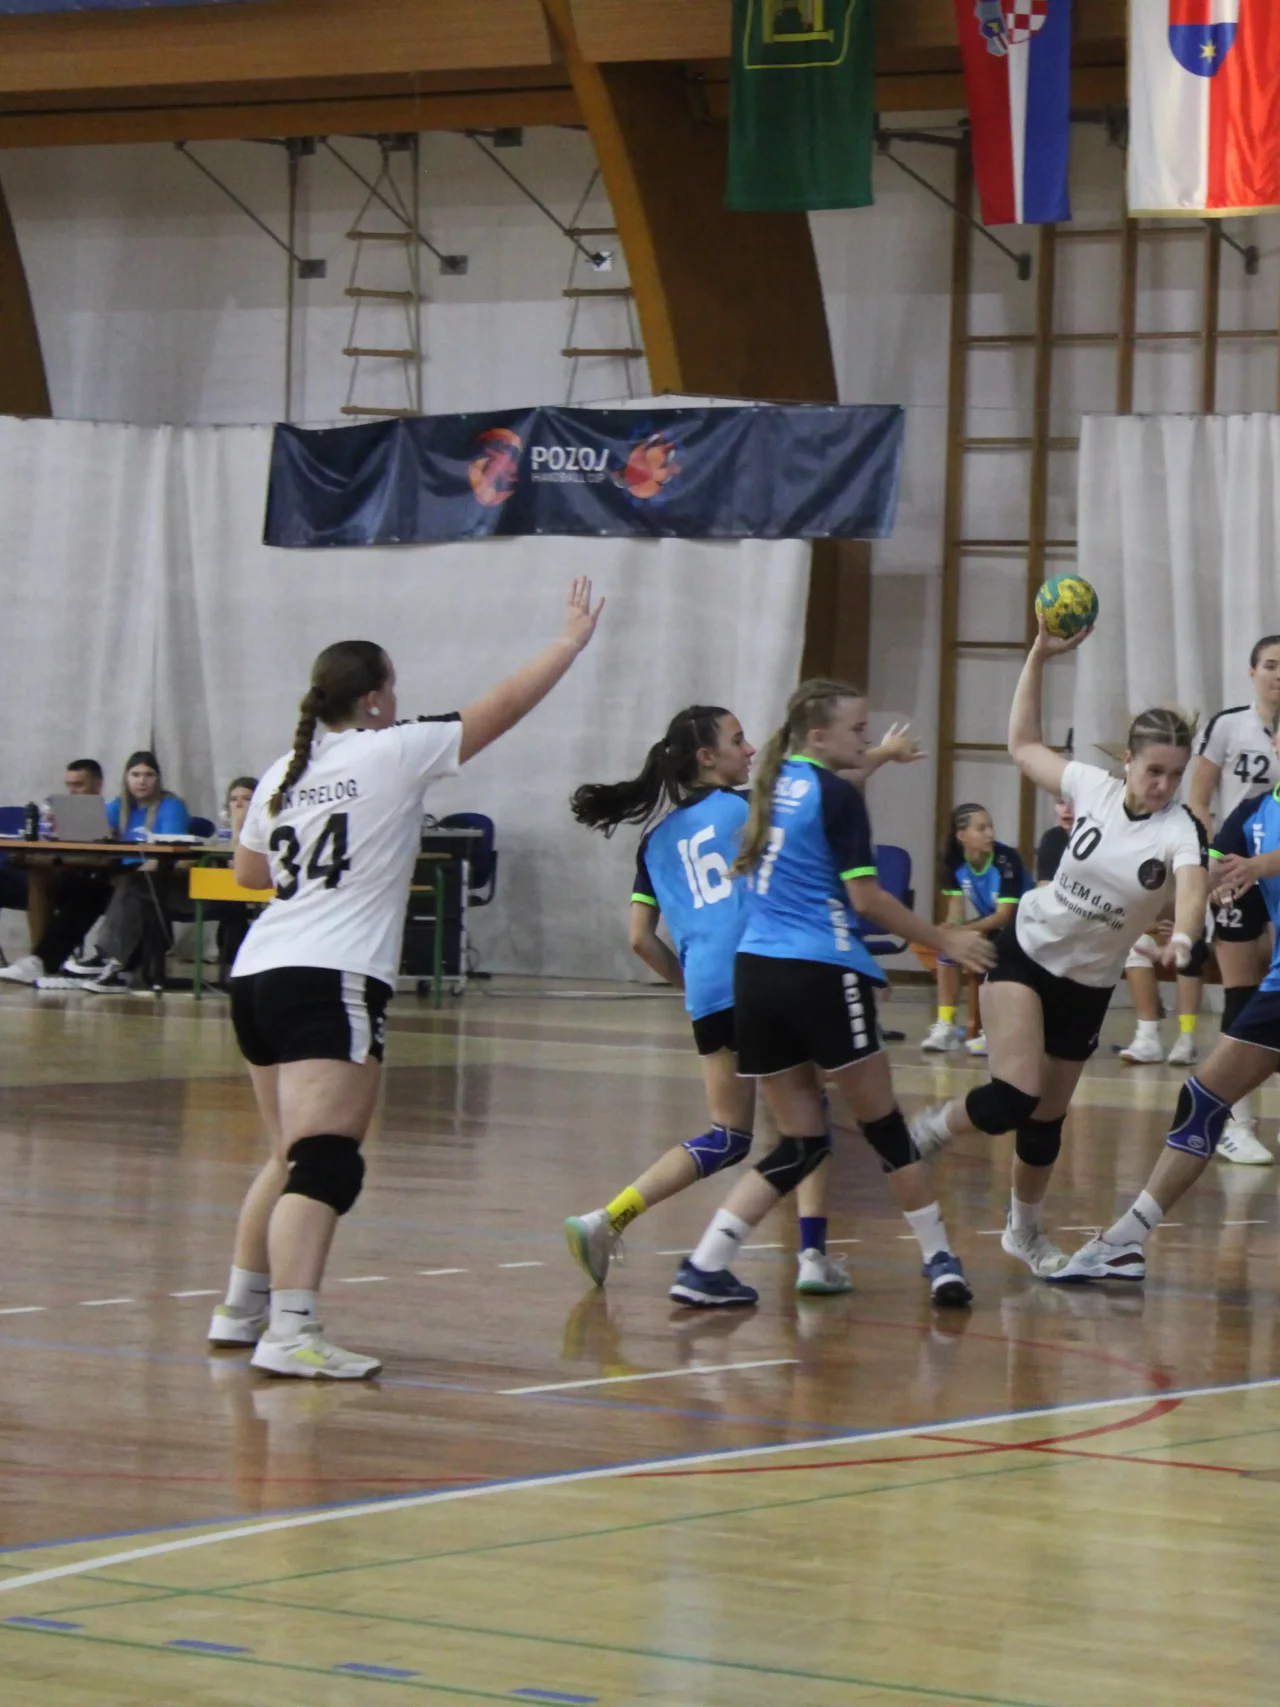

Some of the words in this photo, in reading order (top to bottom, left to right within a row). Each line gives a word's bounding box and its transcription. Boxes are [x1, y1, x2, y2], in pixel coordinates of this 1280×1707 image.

[531, 446, 610, 471] POZOJ
[1233, 753, 1270, 784] 42
[298, 779, 358, 808] PRELOG
[1067, 816, 1103, 861] 10
[269, 812, 351, 900] 34
[677, 825, 733, 909] 16
[1216, 908, 1243, 928] 42
